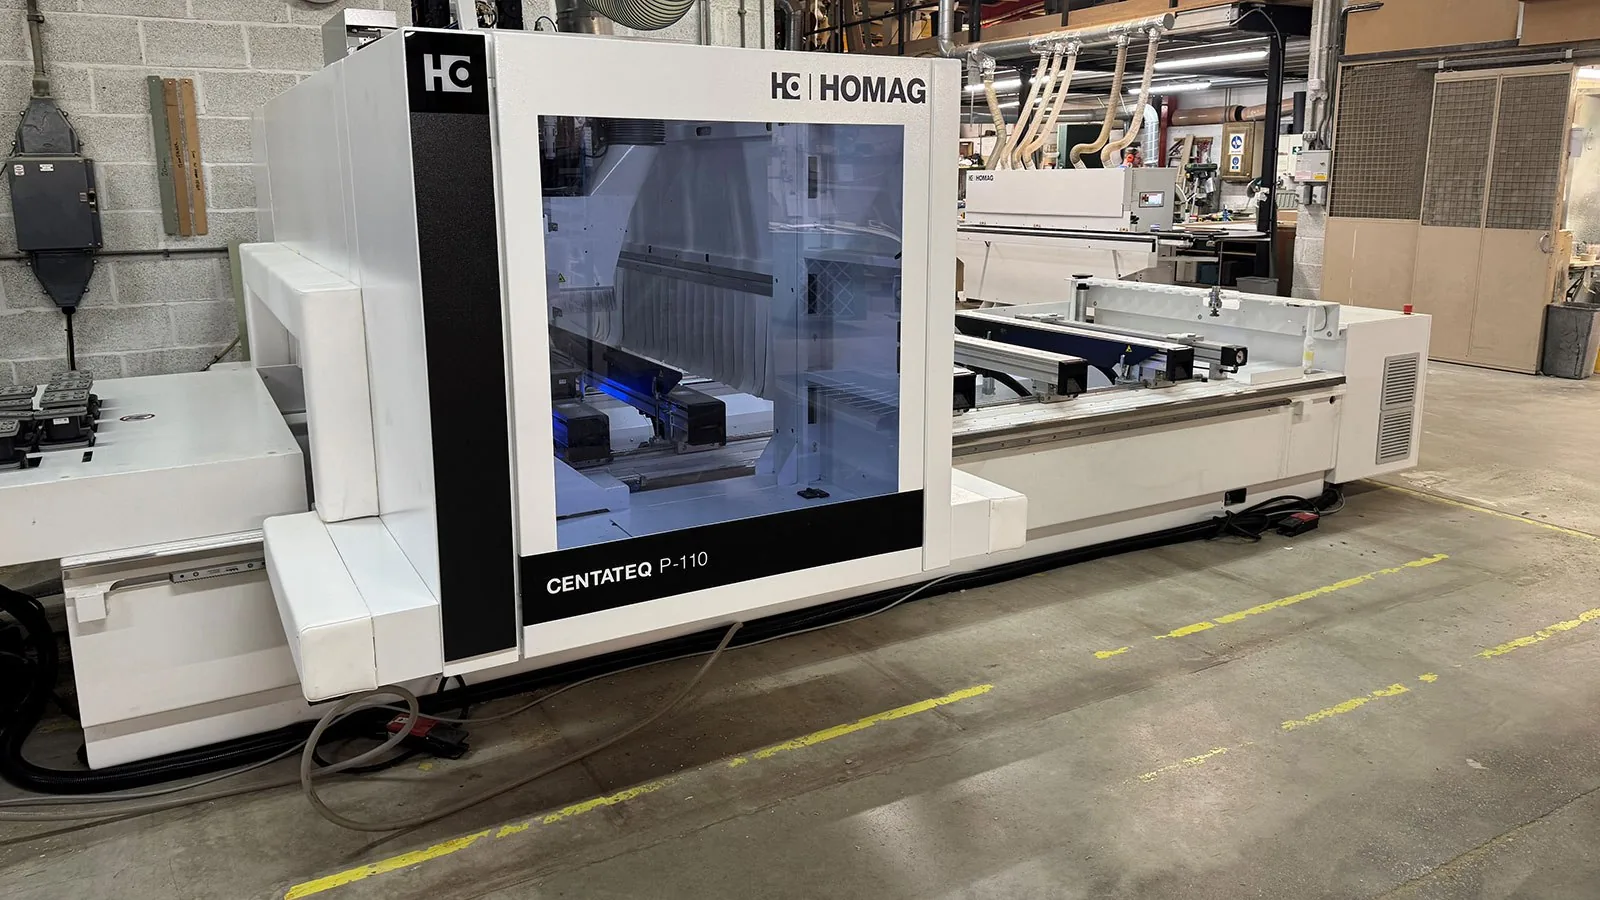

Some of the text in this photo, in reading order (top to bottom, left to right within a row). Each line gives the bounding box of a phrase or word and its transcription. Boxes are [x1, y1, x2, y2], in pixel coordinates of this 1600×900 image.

[820, 73, 926, 104] HOMAG
[975, 174, 994, 182] HOMAG
[546, 551, 708, 595] CENTATEQ P-110
